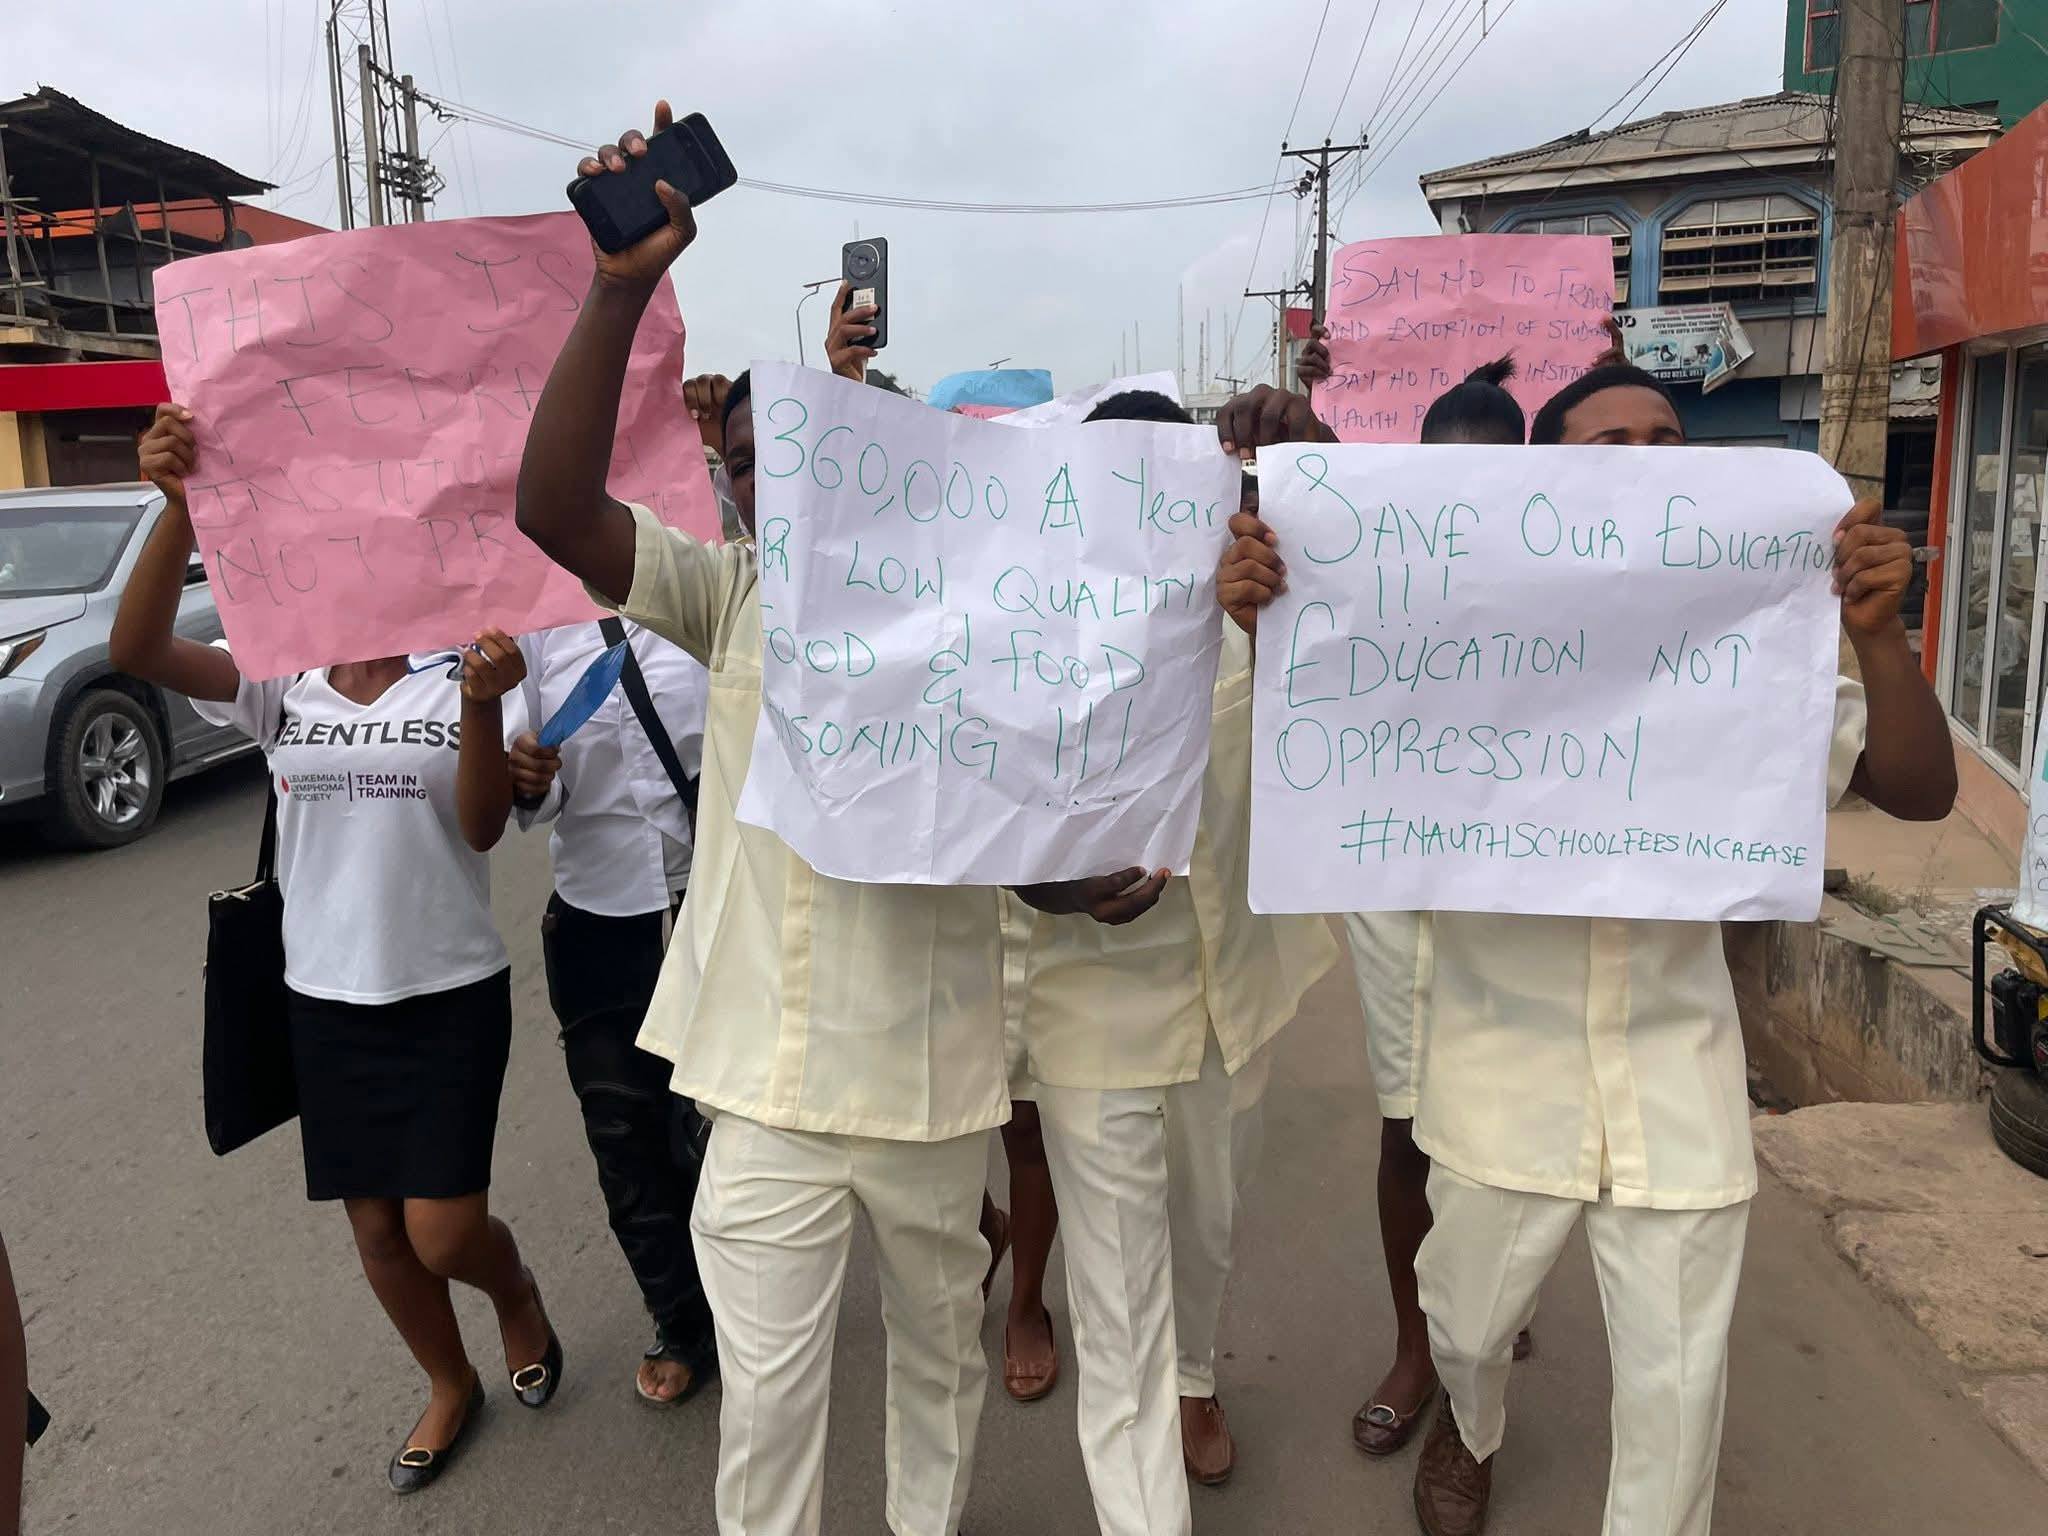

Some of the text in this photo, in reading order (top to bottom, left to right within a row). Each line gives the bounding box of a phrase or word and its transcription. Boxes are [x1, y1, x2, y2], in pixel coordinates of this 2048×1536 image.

[159, 249, 581, 363] THIS IS
[1505, 264, 1536, 297] TO
[1517, 318, 1540, 338] OF
[275, 361, 546, 437] FEDRA
[1429, 366, 1451, 393] TO
[762, 397, 1009, 523] 360,000
[1039, 462, 1084, 538] A
[1111, 456, 1224, 535] Year
[1295, 452, 1481, 565] SAVE
[215, 533, 377, 607] NOT
[845, 539, 944, 606] LOW
[992, 565, 1196, 621] QUALITY
[760, 603, 877, 679] OOD
[1285, 600, 1753, 709] EDUCATION NOT
[278, 718, 462, 751] ELENTLESS
[1275, 715, 1643, 802] OPPRESSION
[288, 774, 335, 784] LEUKEMIA
[290, 783, 345, 793] LYMPHOMA
[293, 793, 332, 802] SOCIETY
[355, 774, 418, 787] TEAM IN
[356, 786, 427, 801] TRAINING
